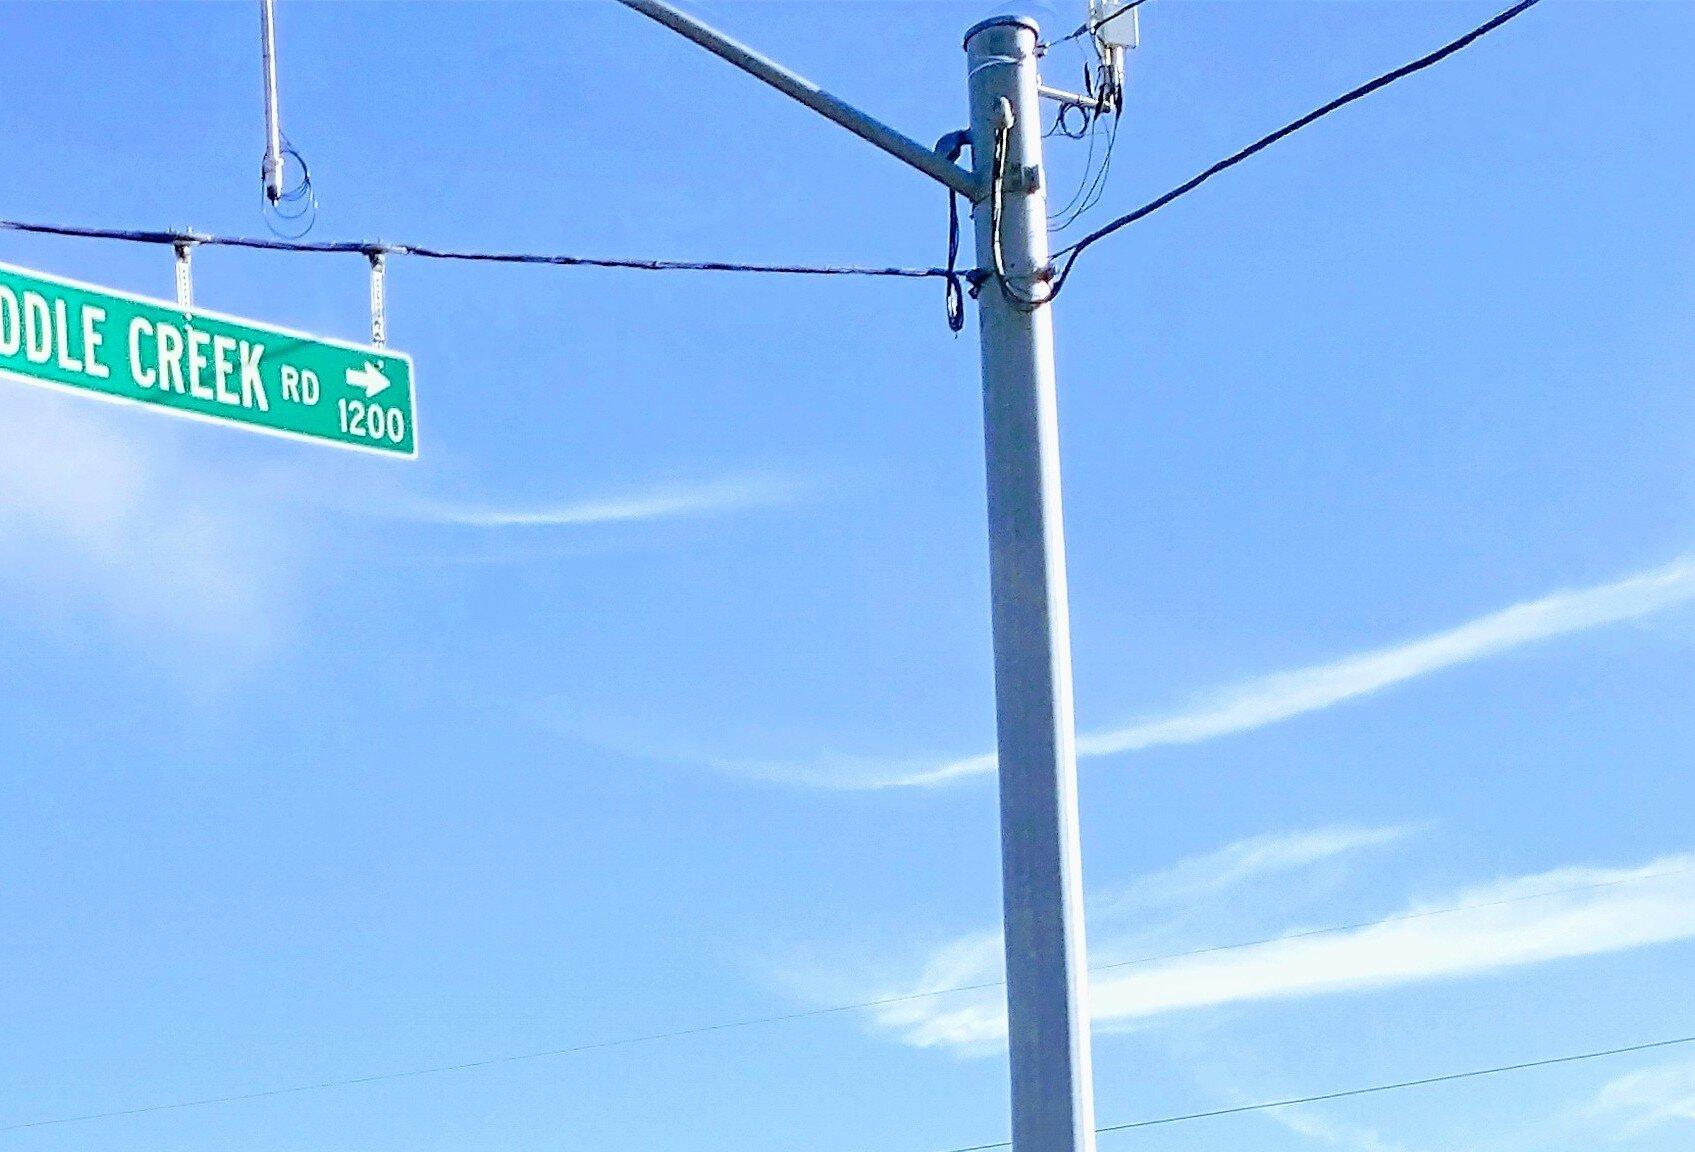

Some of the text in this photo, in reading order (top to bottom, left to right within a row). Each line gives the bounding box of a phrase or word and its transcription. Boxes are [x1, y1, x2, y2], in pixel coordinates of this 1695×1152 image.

[129, 316, 270, 412] CREEK
[281, 363, 320, 406] RD
[338, 398, 406, 444] 1200
